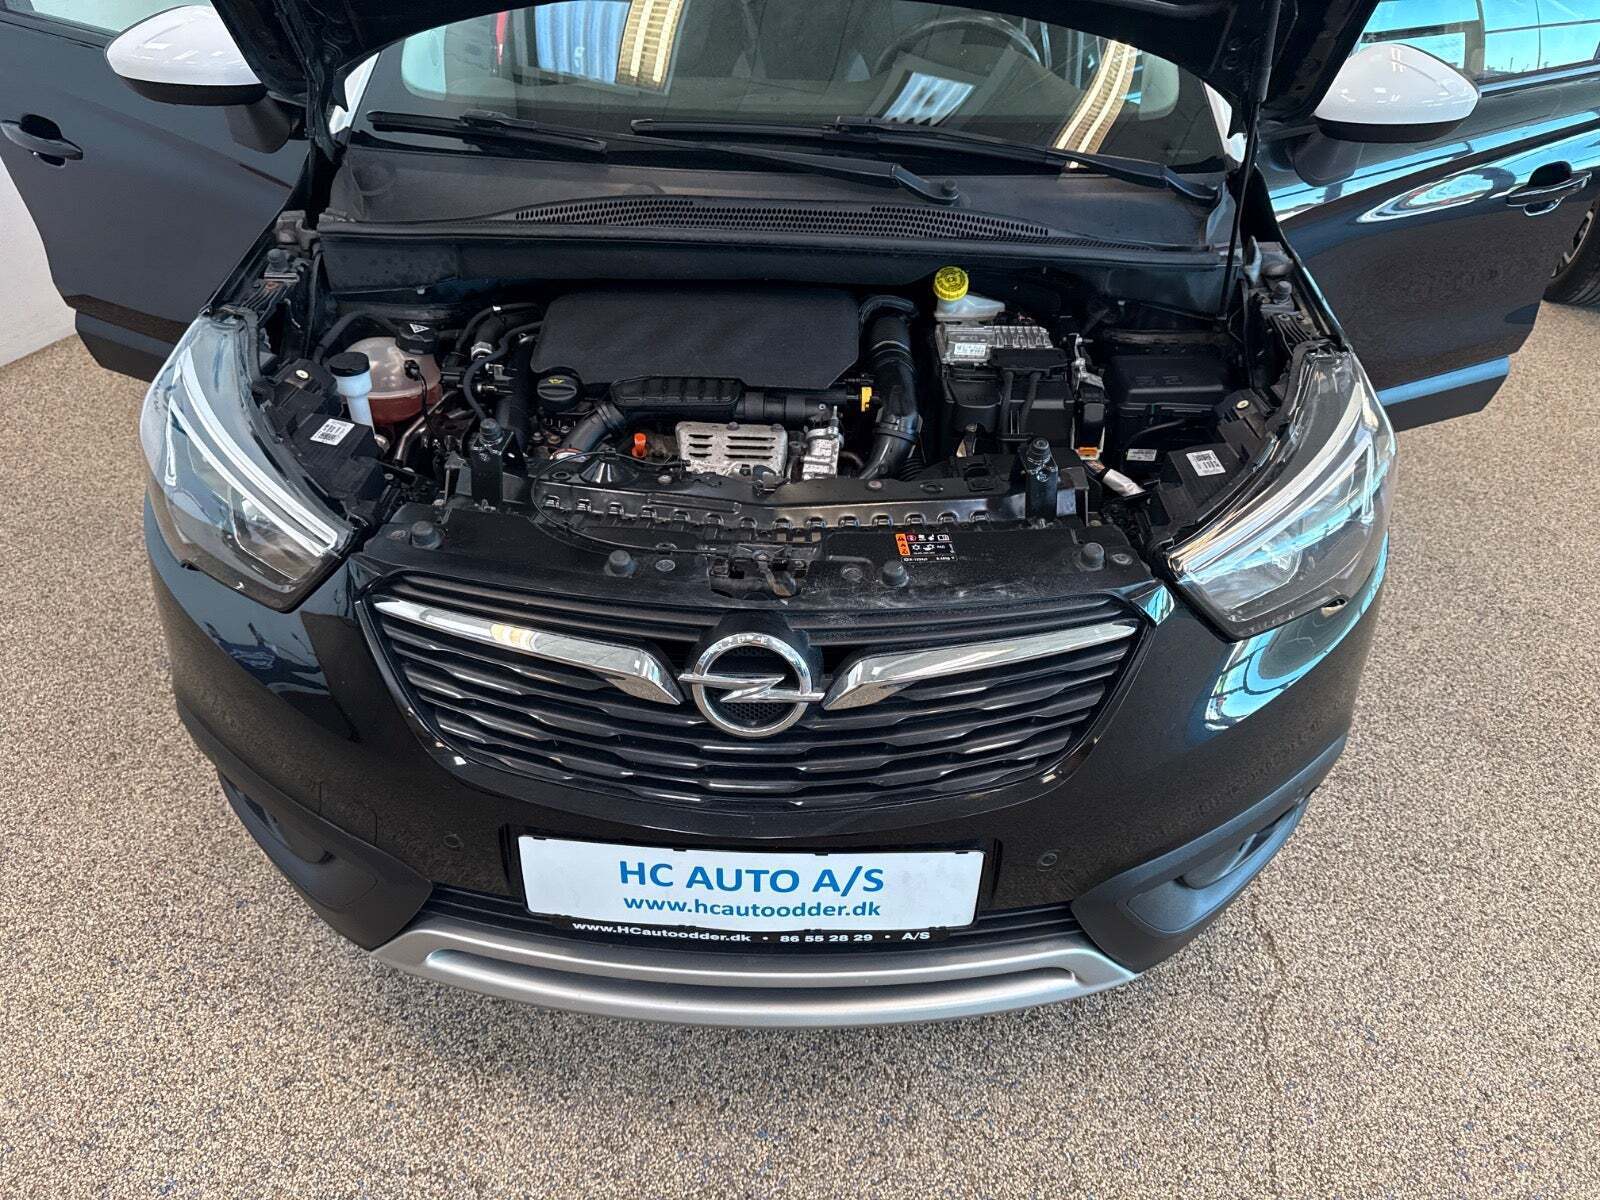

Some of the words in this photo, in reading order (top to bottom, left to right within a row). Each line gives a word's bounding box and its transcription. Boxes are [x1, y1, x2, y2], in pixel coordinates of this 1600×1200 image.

[619, 860, 673, 887] HC
[685, 865, 800, 893] AUTO
[812, 865, 884, 896] A/S
[623, 897, 881, 918] www.hcautoodder.dk
[572, 922, 750, 942] www.HCautoodder.dk
[780, 935, 799, 943] 86
[805, 935, 825, 943] 55
[829, 934, 849, 942] 28
[854, 934, 873, 942] 29
[902, 931, 931, 941] A/S
